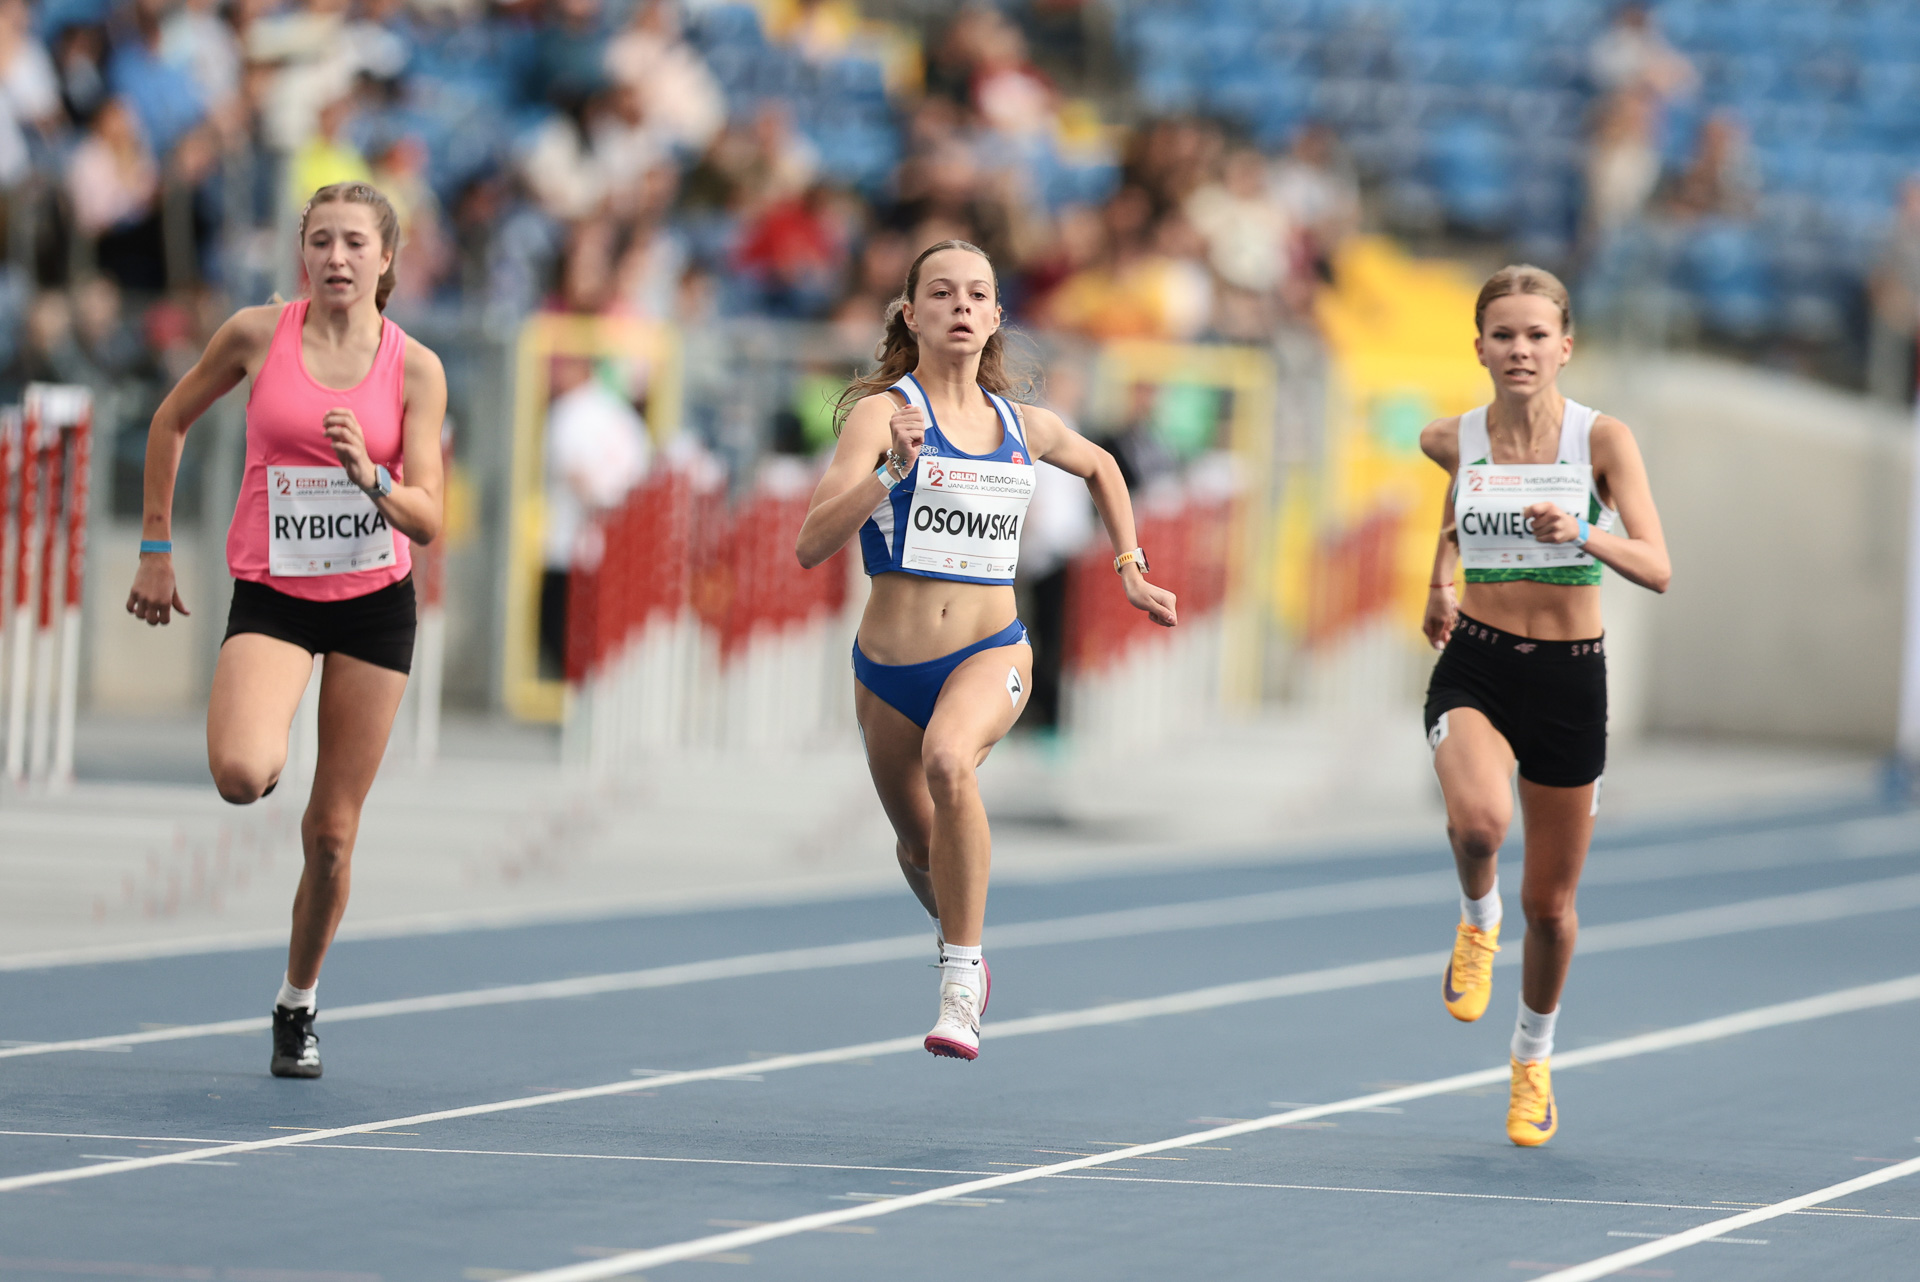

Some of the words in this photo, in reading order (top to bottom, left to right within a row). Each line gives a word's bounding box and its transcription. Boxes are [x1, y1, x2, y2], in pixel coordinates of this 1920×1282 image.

[950, 471, 977, 482] ORLEN
[980, 474, 1031, 486] MEMORIAŁ
[275, 512, 387, 540] RYBICKA
[914, 505, 1018, 540] OSOWSKA
